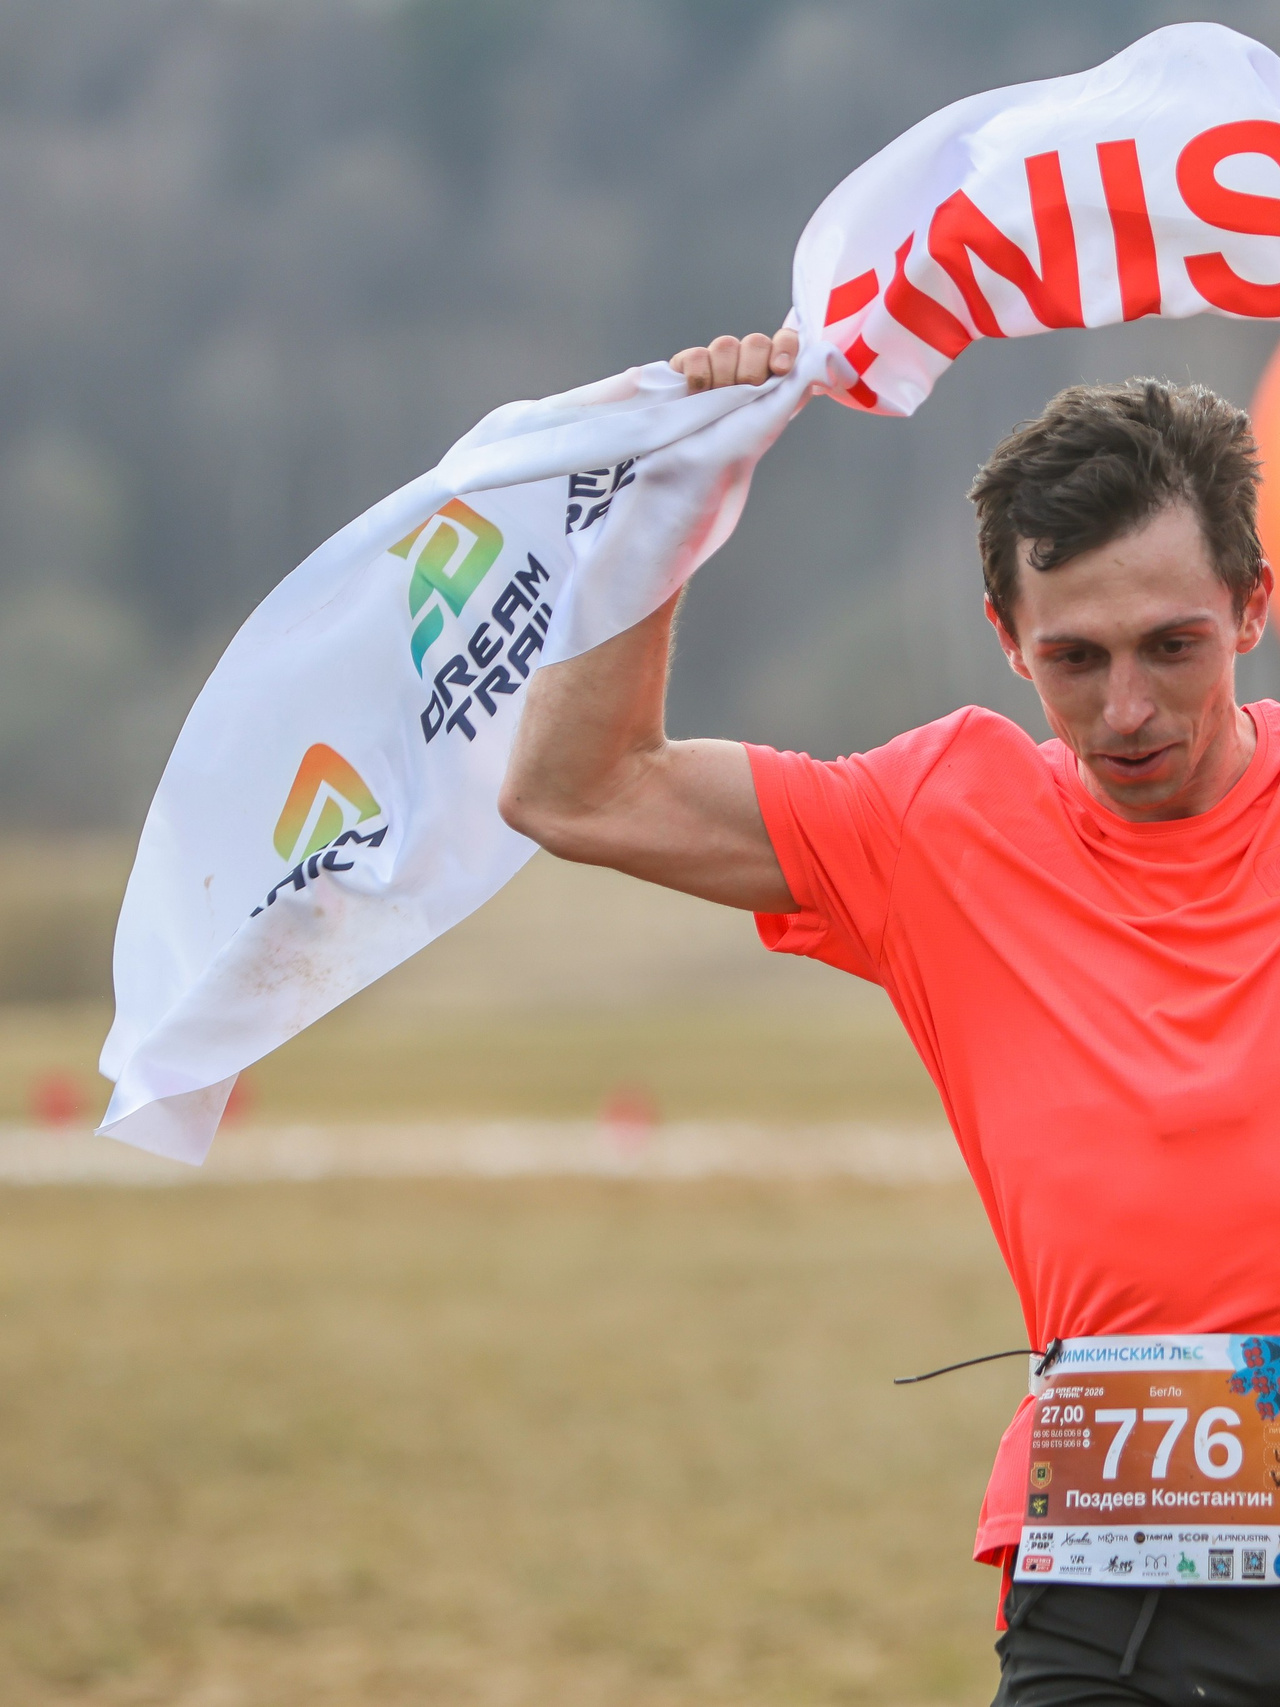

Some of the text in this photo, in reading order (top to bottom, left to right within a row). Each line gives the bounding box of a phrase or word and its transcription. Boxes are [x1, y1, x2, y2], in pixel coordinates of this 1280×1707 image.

[420, 552, 550, 744] DREAM
[1056, 1343, 1204, 1364] ХИМКИНСКИЙ ЛЕС
[1055, 1386, 1084, 1394] DREAM
[1084, 1387, 1104, 1397] 2026
[1150, 1386, 1182, 1398] БегЛо
[1041, 1405, 1084, 1426] 27,00
[1095, 1406, 1243, 1479] 776
[1066, 1488, 1273, 1511] Поздеев Константин
